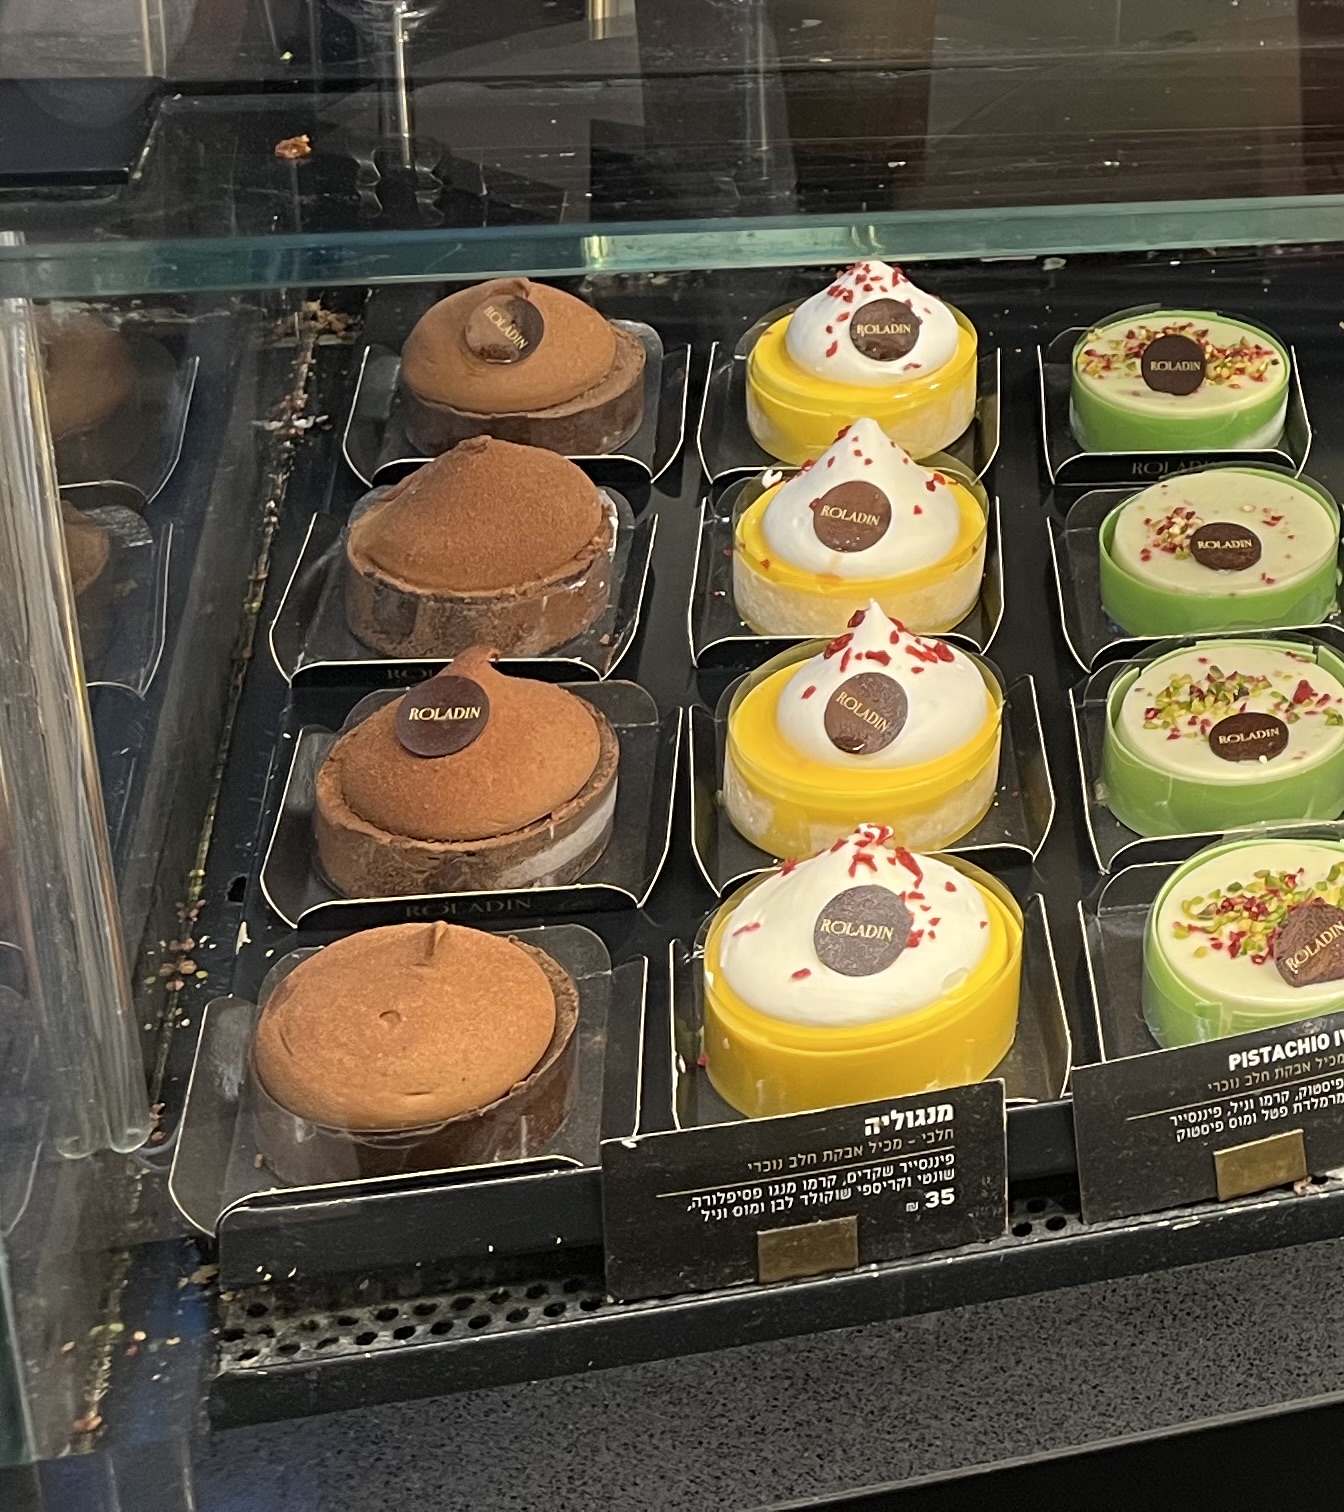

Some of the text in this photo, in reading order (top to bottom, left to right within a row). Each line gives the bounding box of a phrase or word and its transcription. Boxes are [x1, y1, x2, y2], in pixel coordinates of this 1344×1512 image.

[485, 304, 529, 351] ROLADIN
[856, 322, 912, 338] ROLADIN
[1150, 359, 1202, 372] ROLADIN
[820, 504, 881, 526] ROLADIN
[1197, 539, 1253, 551] ROLADIN
[408, 706, 482, 722] ROLADIN
[836, 691, 892, 733] ROLADIN
[1218, 726, 1280, 745] ROLADIN
[820, 918, 894, 942] ROLADIN
[1229, 1033, 1329, 1071] PISTACHIO
[865, 1104, 953, 1136] מנגוליה
[925, 1188, 955, 1208] 35
